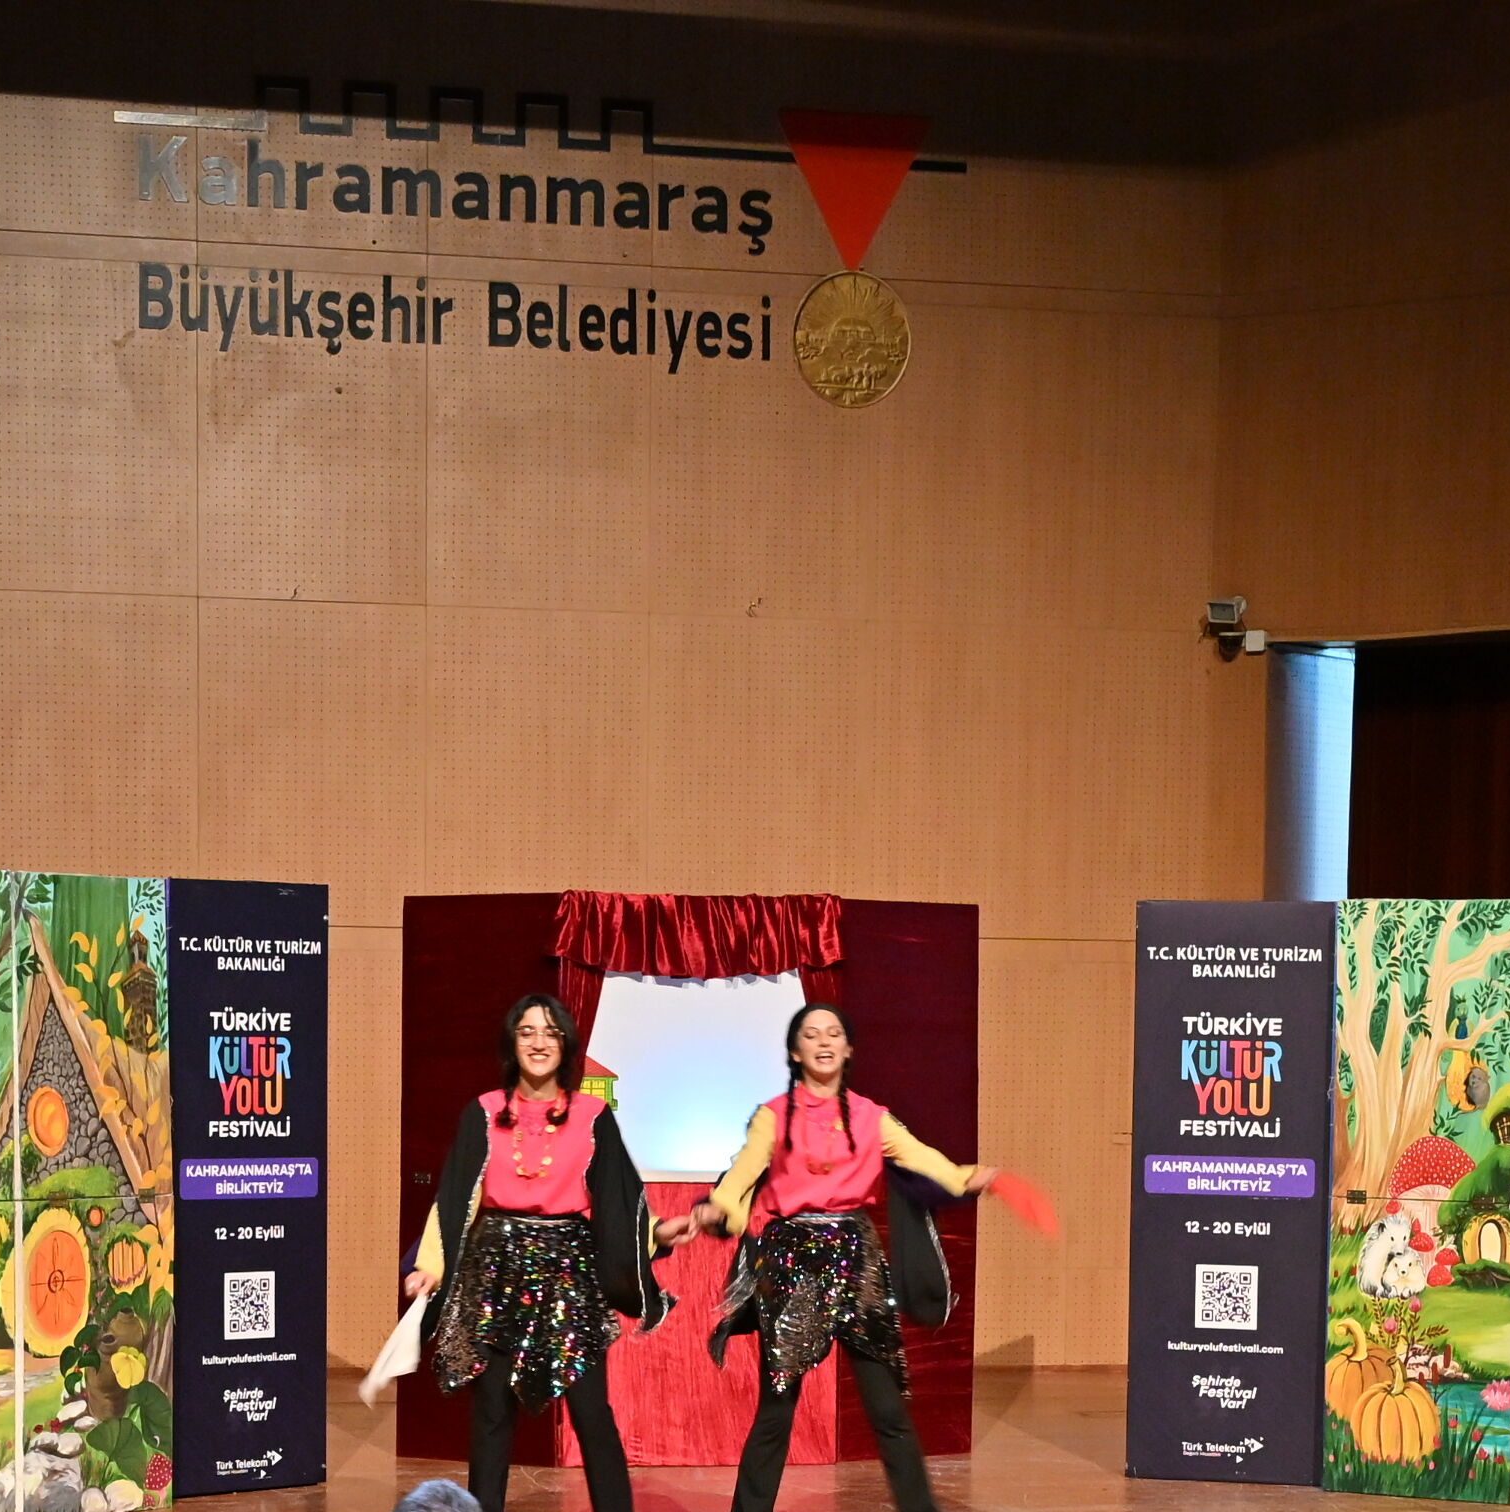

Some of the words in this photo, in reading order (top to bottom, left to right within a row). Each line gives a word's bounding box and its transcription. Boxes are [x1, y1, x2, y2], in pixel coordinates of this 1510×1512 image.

[136, 132, 773, 256] Kahramanmaraş
[137, 262, 453, 355] Büyükşehir
[489, 281, 772, 375] Belediyesi
[178, 936, 202, 952] T.C.
[204, 935, 253, 953] KÜLTÜR
[255, 939, 272, 954] VE
[274, 938, 322, 955] TURİZM
[1146, 946, 1174, 961] T.C.
[1176, 944, 1236, 961] KÜLTÜR
[1239, 947, 1259, 961] VE
[1262, 945, 1323, 962] TURİZM
[217, 955, 285, 972] BAKANLIĞI
[1192, 962, 1276, 979] BAKANLIĞI
[209, 1006, 292, 1032] TÜRKİYE
[1182, 1011, 1283, 1037] TÜRKİYE
[209, 1036, 291, 1079] KÜLTÜR
[1181, 1040, 1283, 1082] KÜLTÜR
[219, 1076, 283, 1116] YOLU
[1193, 1076, 1271, 1116] YOLU
[208, 1115, 291, 1138] FESTİVALİ
[1179, 1115, 1281, 1138] FESTİVALİ
[186, 1163, 313, 1178] KAHRAMANMARAŞ'TA
[1151, 1160, 1308, 1177] KAHRAMANMARAŞ'TA
[215, 1179, 284, 1195] BİRLİKTEYİZ
[1187, 1175, 1272, 1193] BİRLİKTEYİZ
[214, 1227, 228, 1240] 12
[237, 1226, 253, 1240] 20
[255, 1225, 285, 1242] Eylül
[1184, 1220, 1200, 1234] 12
[1212, 1221, 1232, 1235] 20
[1234, 1221, 1271, 1238] Eylül
[1167, 1340, 1284, 1355] kulturyolufestivali.com
[202, 1351, 297, 1366] kulturyolufestivali.com
[1192, 1375, 1241, 1388] Şehirde
[223, 1387, 263, 1402] Şehirde
[1199, 1386, 1257, 1400] Festival
[229, 1398, 277, 1412] Festival
[1220, 1398, 1247, 1409] Var!
[247, 1410, 268, 1422] Var!
[1182, 1441, 1203, 1452] Türk
[1205, 1442, 1245, 1454] Telekom
[216, 1460, 233, 1470] Türk
[235, 1458, 268, 1468] Telekom
